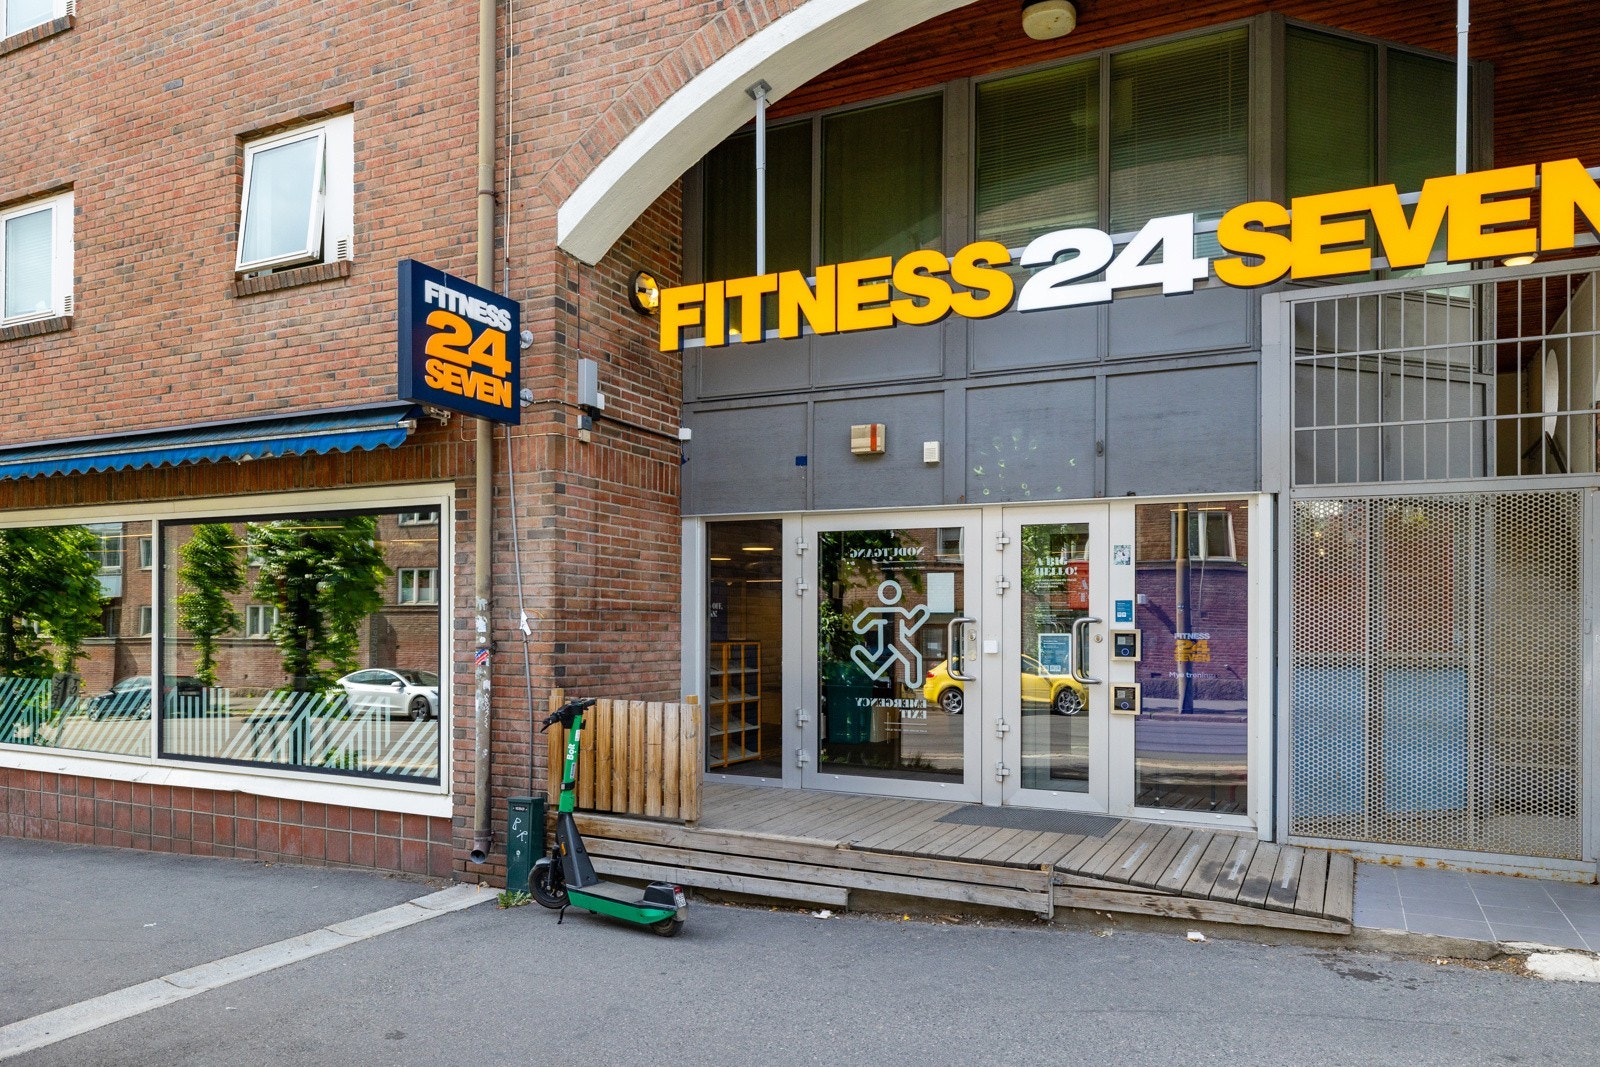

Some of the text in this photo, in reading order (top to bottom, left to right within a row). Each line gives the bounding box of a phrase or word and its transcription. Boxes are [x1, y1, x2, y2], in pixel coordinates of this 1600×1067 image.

[659, 158, 1600, 353] FITNESS 24 SEVEN
[424, 279, 512, 332] FITNESS
[424, 309, 512, 378] 24
[424, 358, 512, 408] SEVEN
[1046, 556, 1068, 567] BIG
[1034, 566, 1078, 576] HELLO!
[1174, 632, 1211, 640] FITNESS
[1174, 639, 1211, 654] 24
[1174, 653, 1211, 662] SEVEN
[566, 743, 577, 761] Bolt
